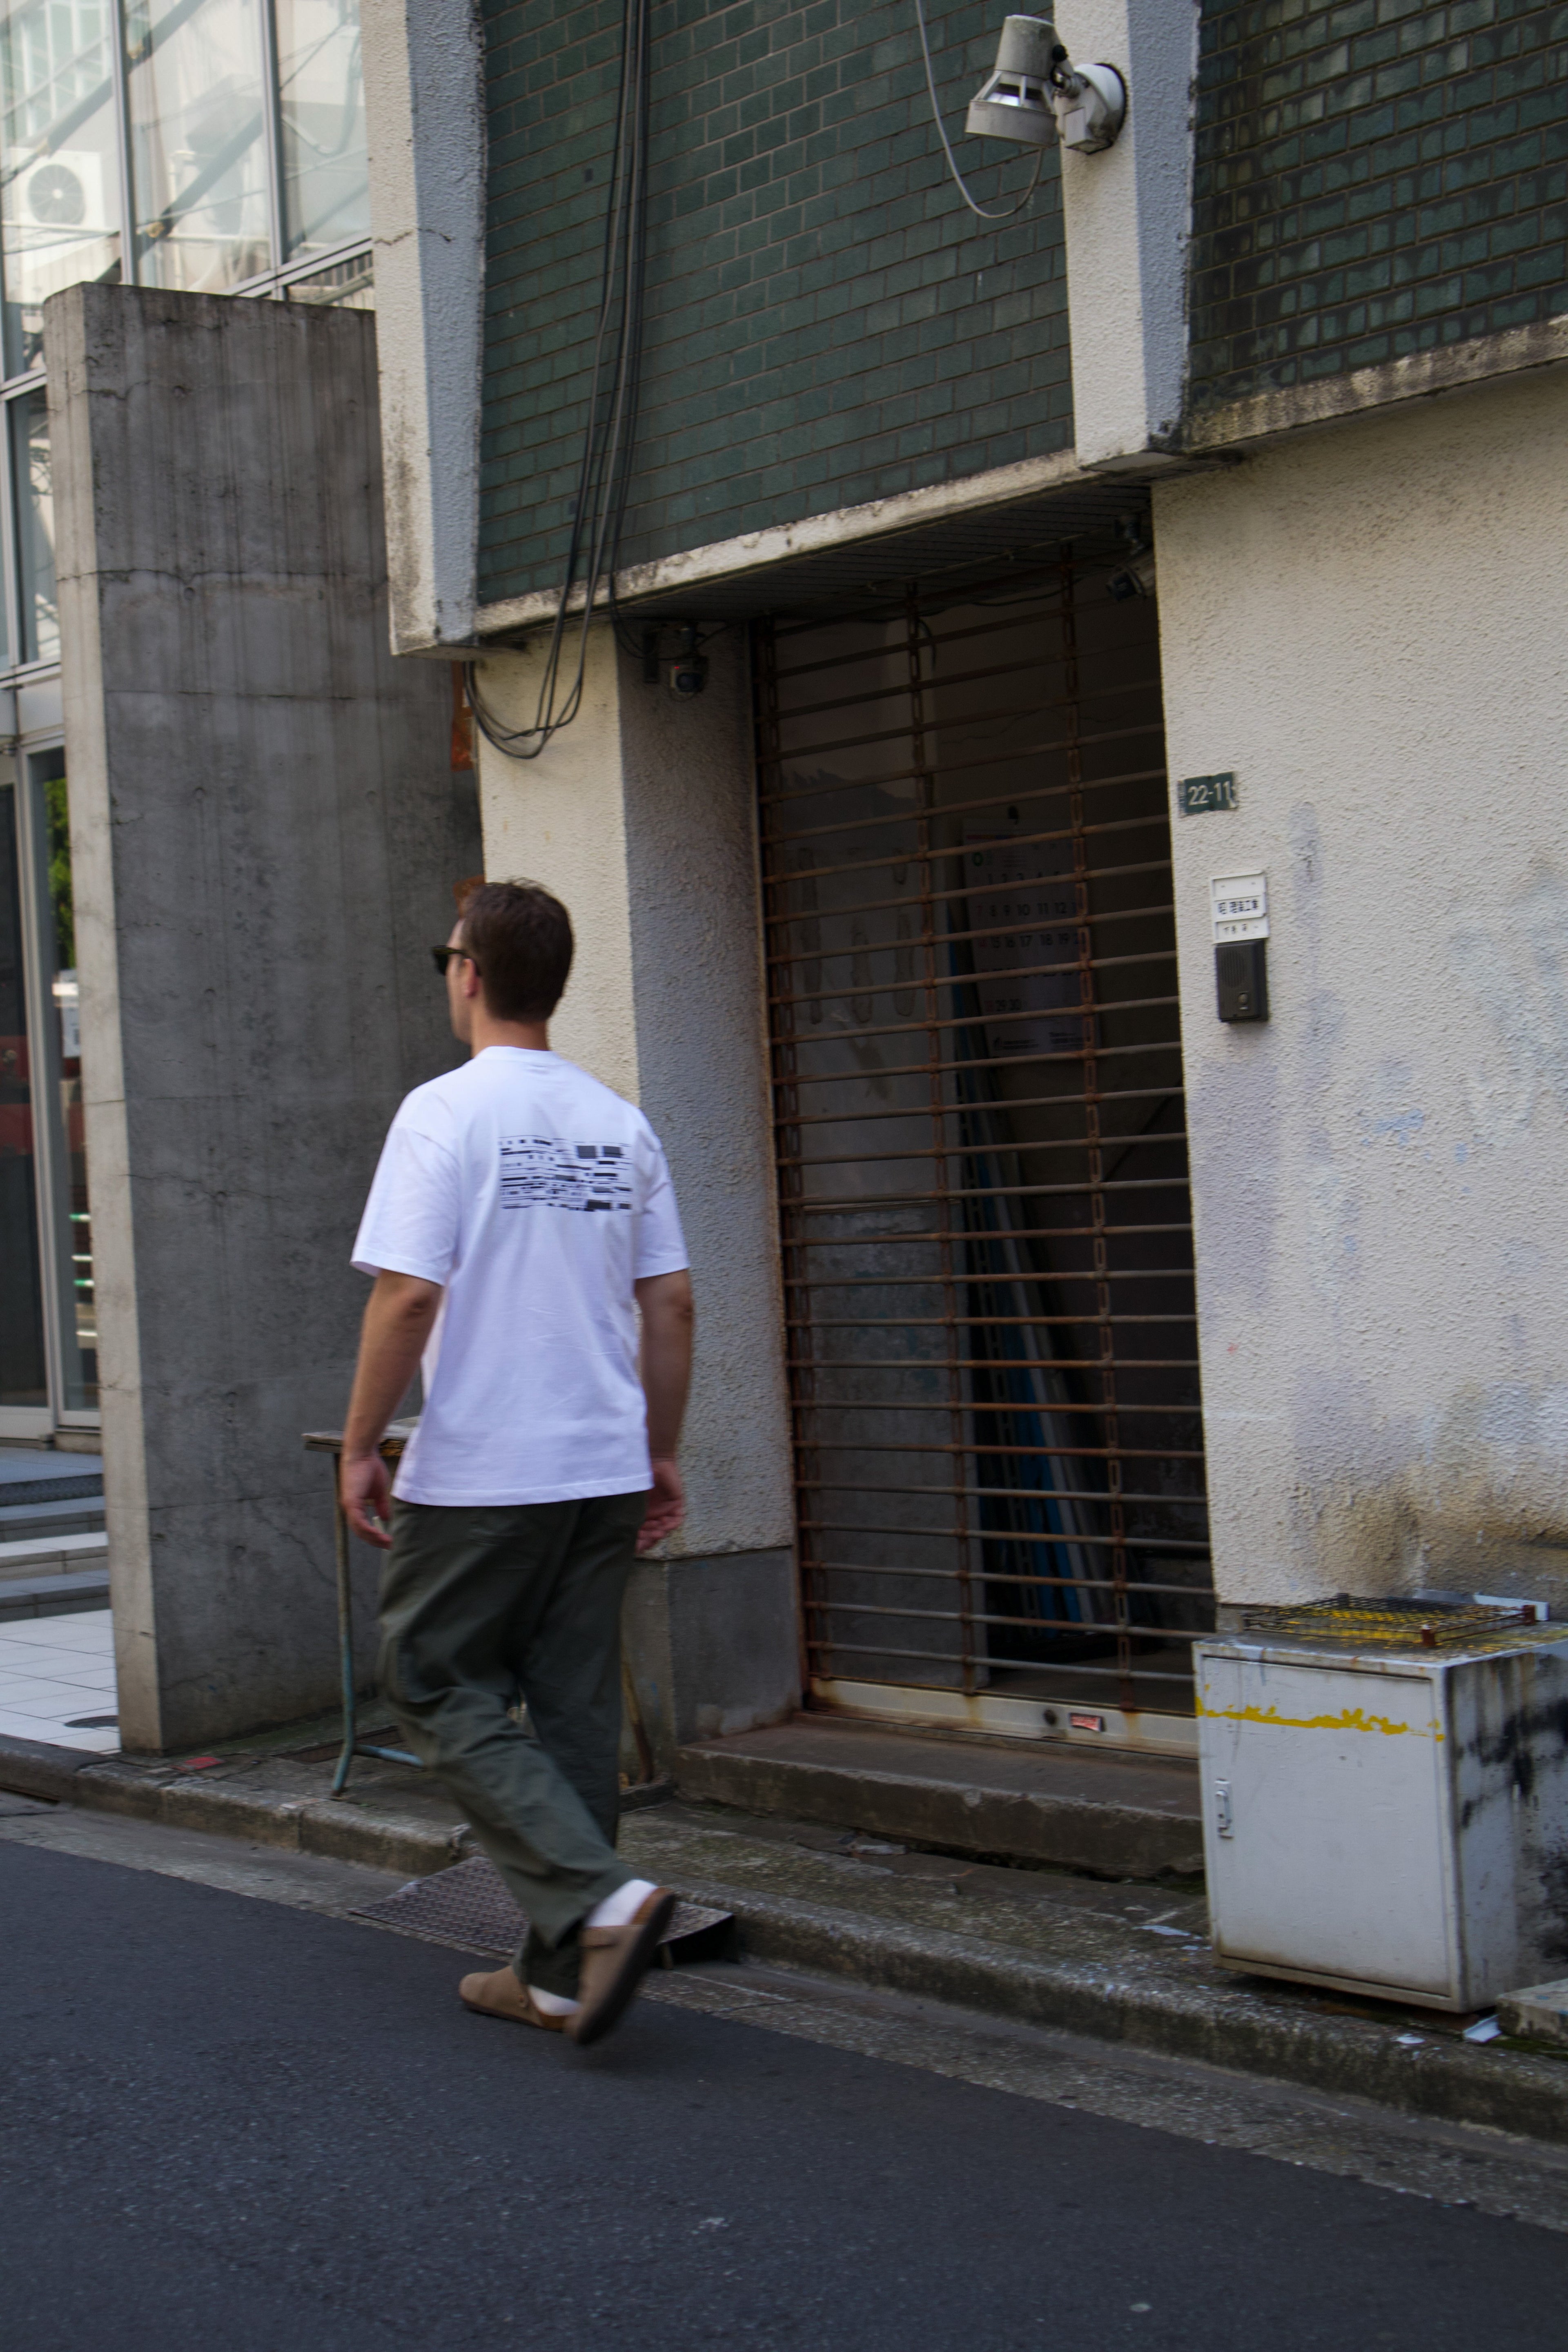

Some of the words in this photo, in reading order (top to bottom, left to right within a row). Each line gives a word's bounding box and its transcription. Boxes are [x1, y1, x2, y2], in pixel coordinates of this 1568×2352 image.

[1187, 781, 1231, 806] 22-11
[1017, 904, 1030, 915] 10
[1037, 902, 1049, 914] 11
[1054, 902, 1067, 914] 12
[1020, 935, 1032, 947] 17
[1040, 934, 1054, 946] 18
[1058, 933, 1070, 945] 19
